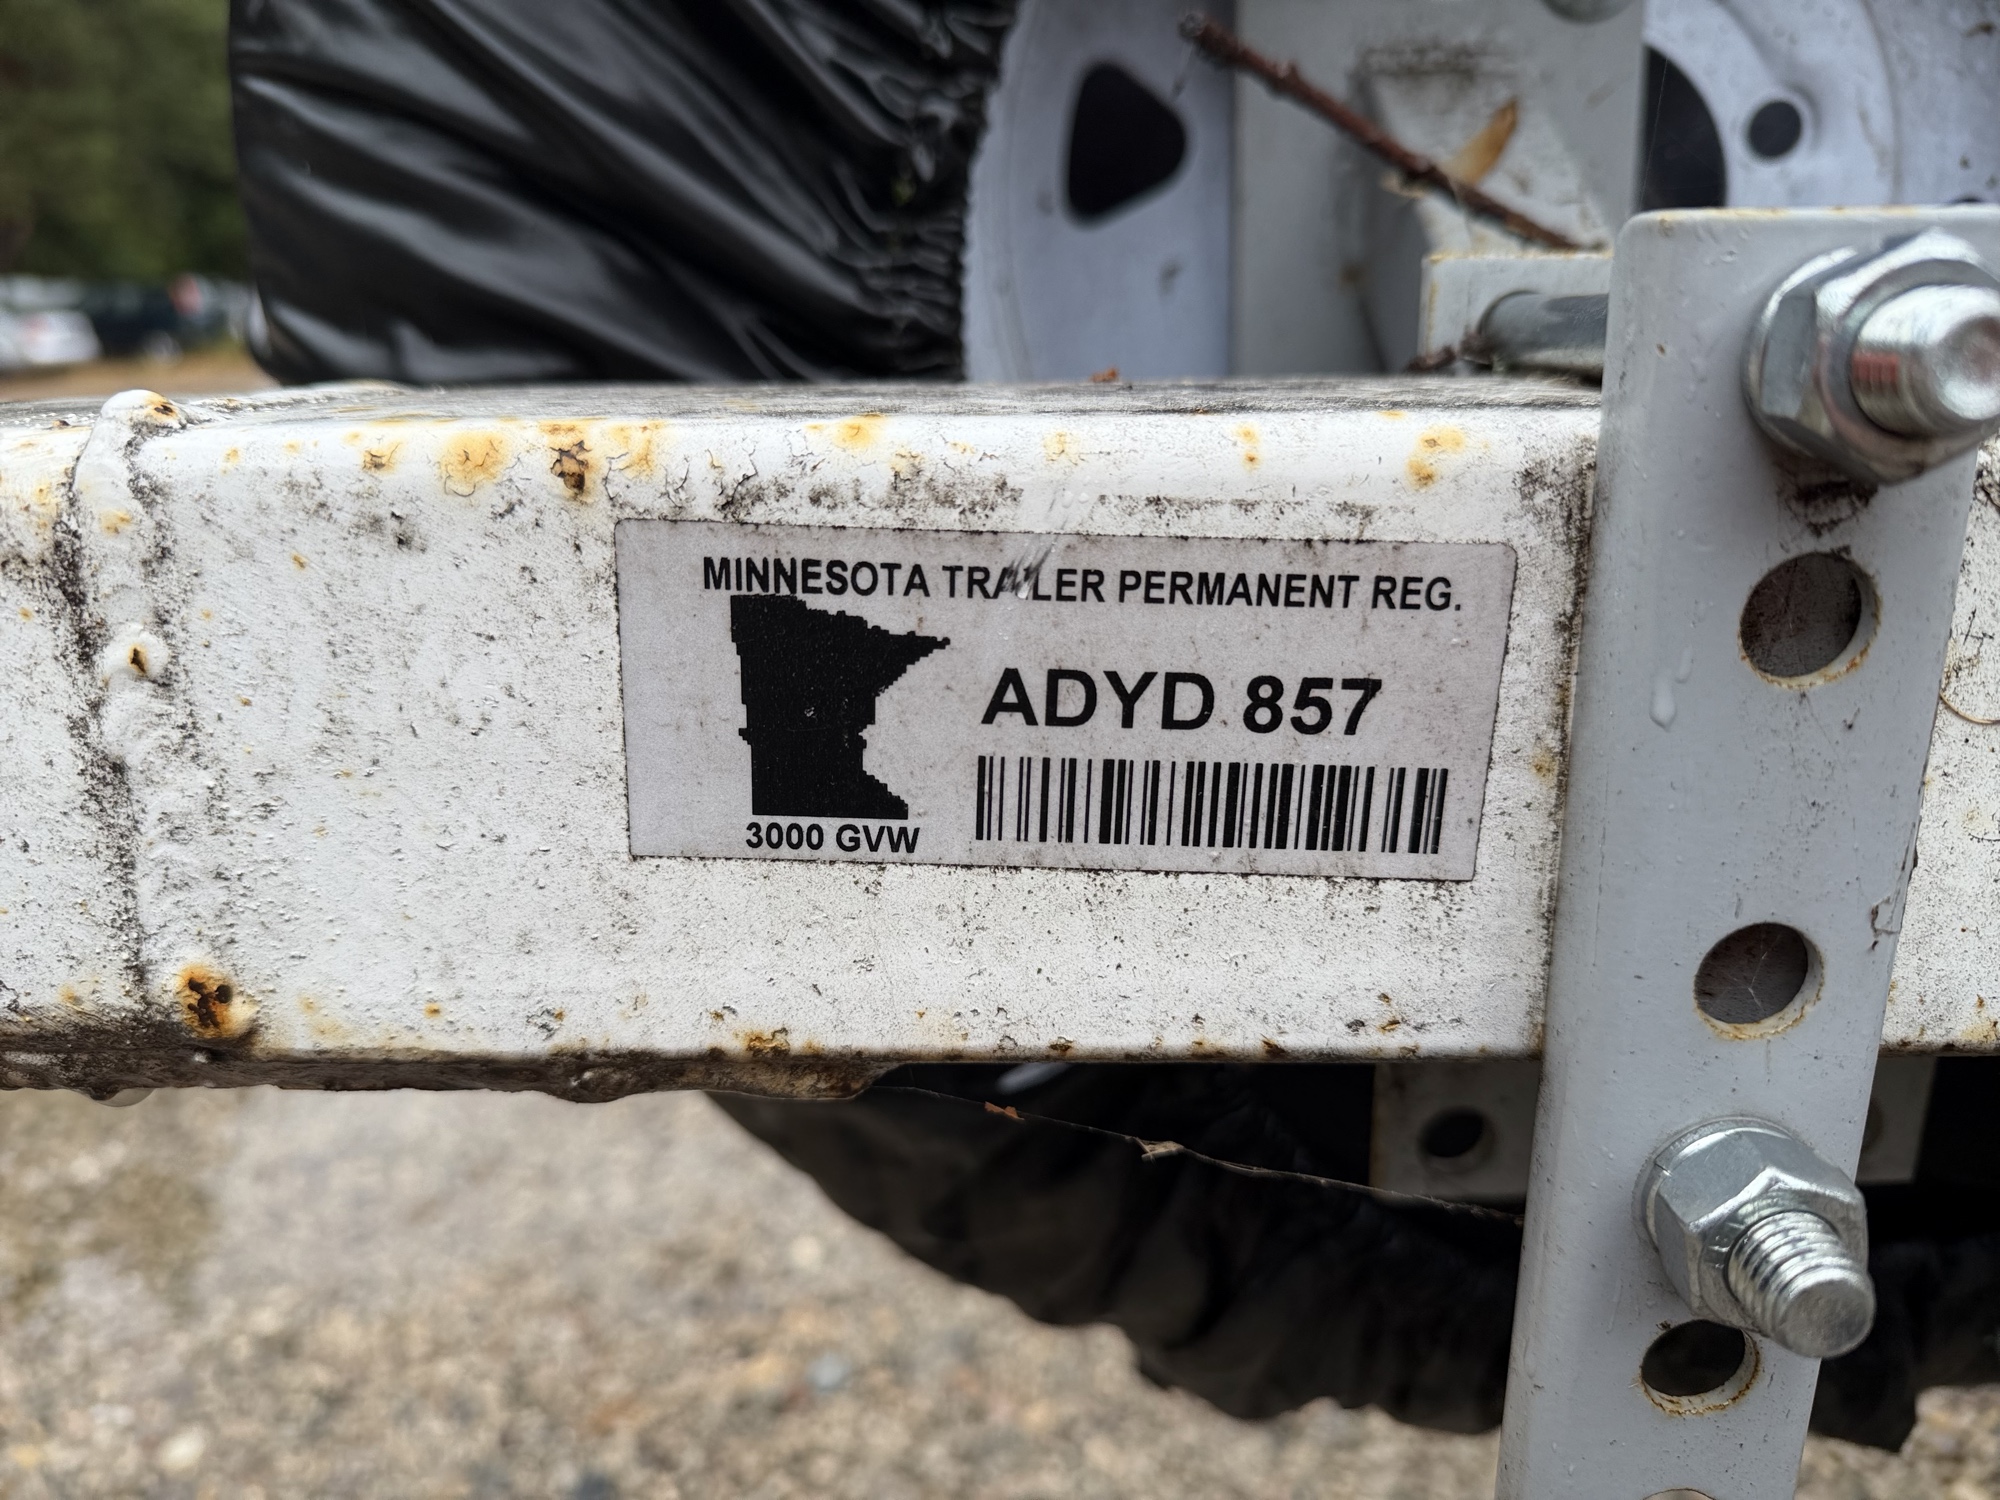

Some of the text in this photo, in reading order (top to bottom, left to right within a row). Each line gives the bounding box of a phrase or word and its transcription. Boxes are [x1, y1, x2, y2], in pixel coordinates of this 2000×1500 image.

[703, 556, 931, 598] MINNESOTA
[1118, 569, 1360, 608] PERMANENT
[1371, 575, 1462, 612] REG.
[980, 667, 1384, 736] ADYD 857
[744, 822, 921, 854] 3000 GVW
